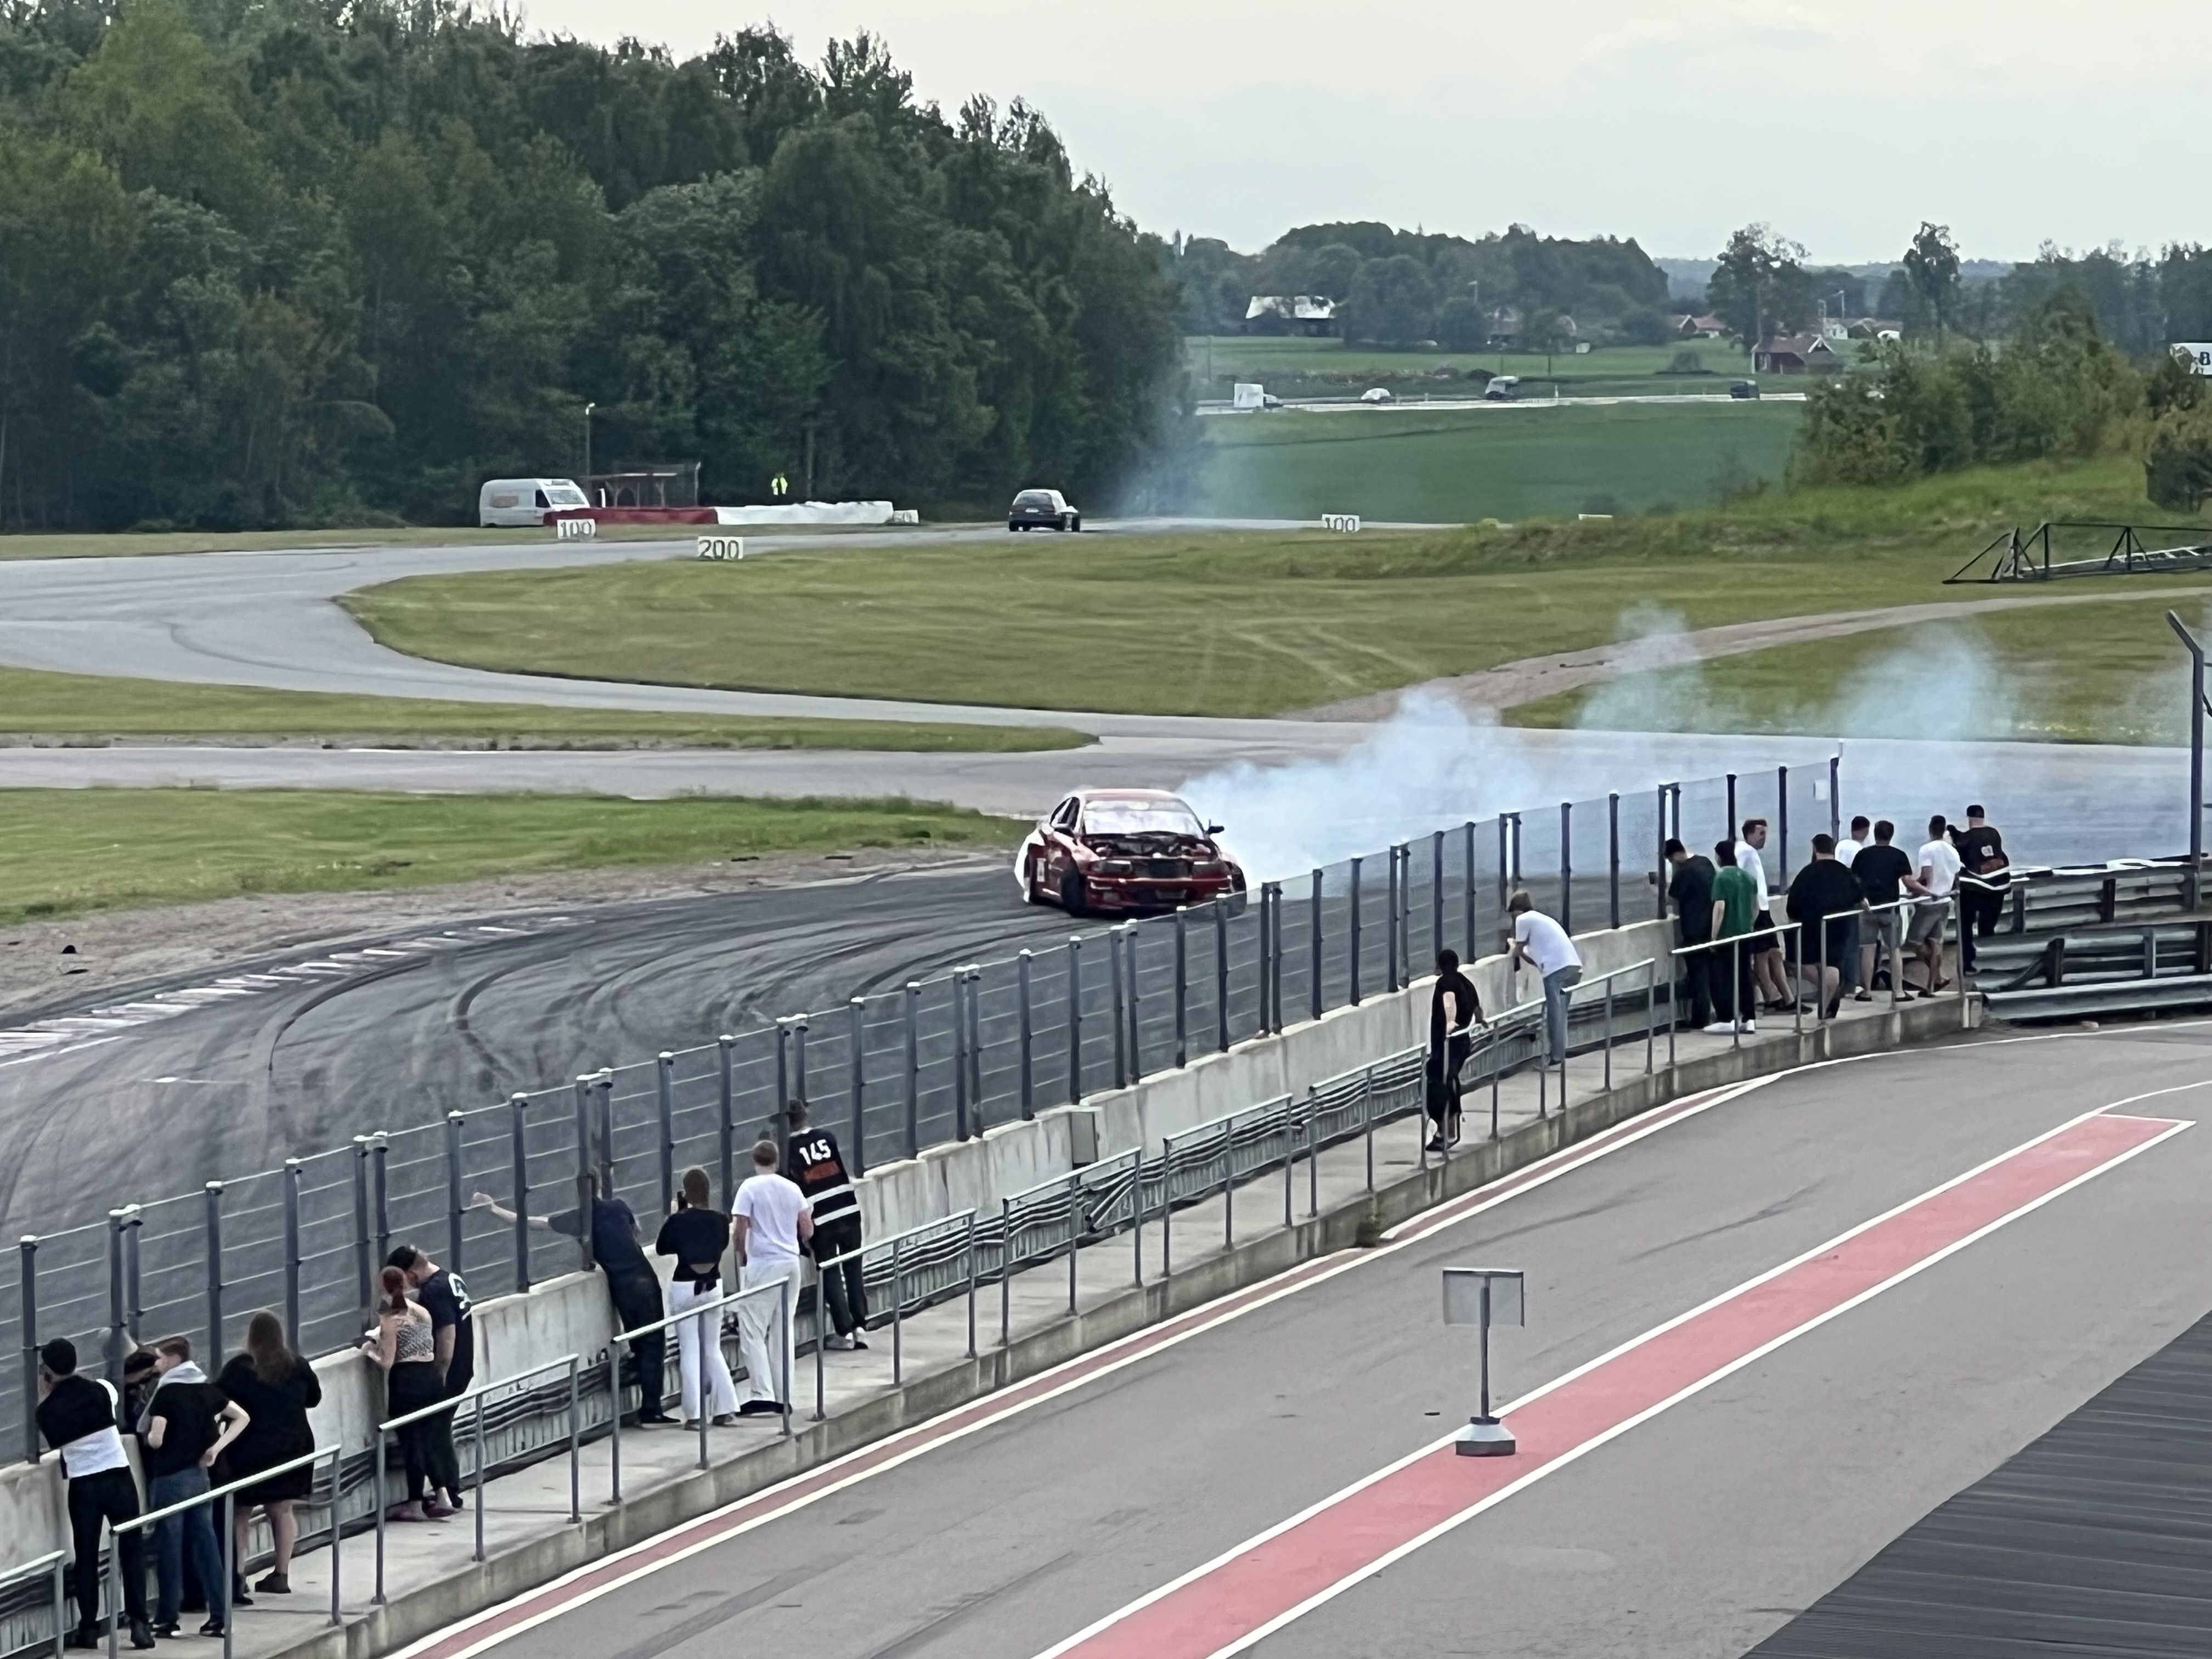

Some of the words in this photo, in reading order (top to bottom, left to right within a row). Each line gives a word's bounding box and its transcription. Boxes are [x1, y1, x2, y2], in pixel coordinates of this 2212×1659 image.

[561, 521, 592, 537] 100
[1324, 517, 1356, 532] 100
[699, 539, 740, 560] 200
